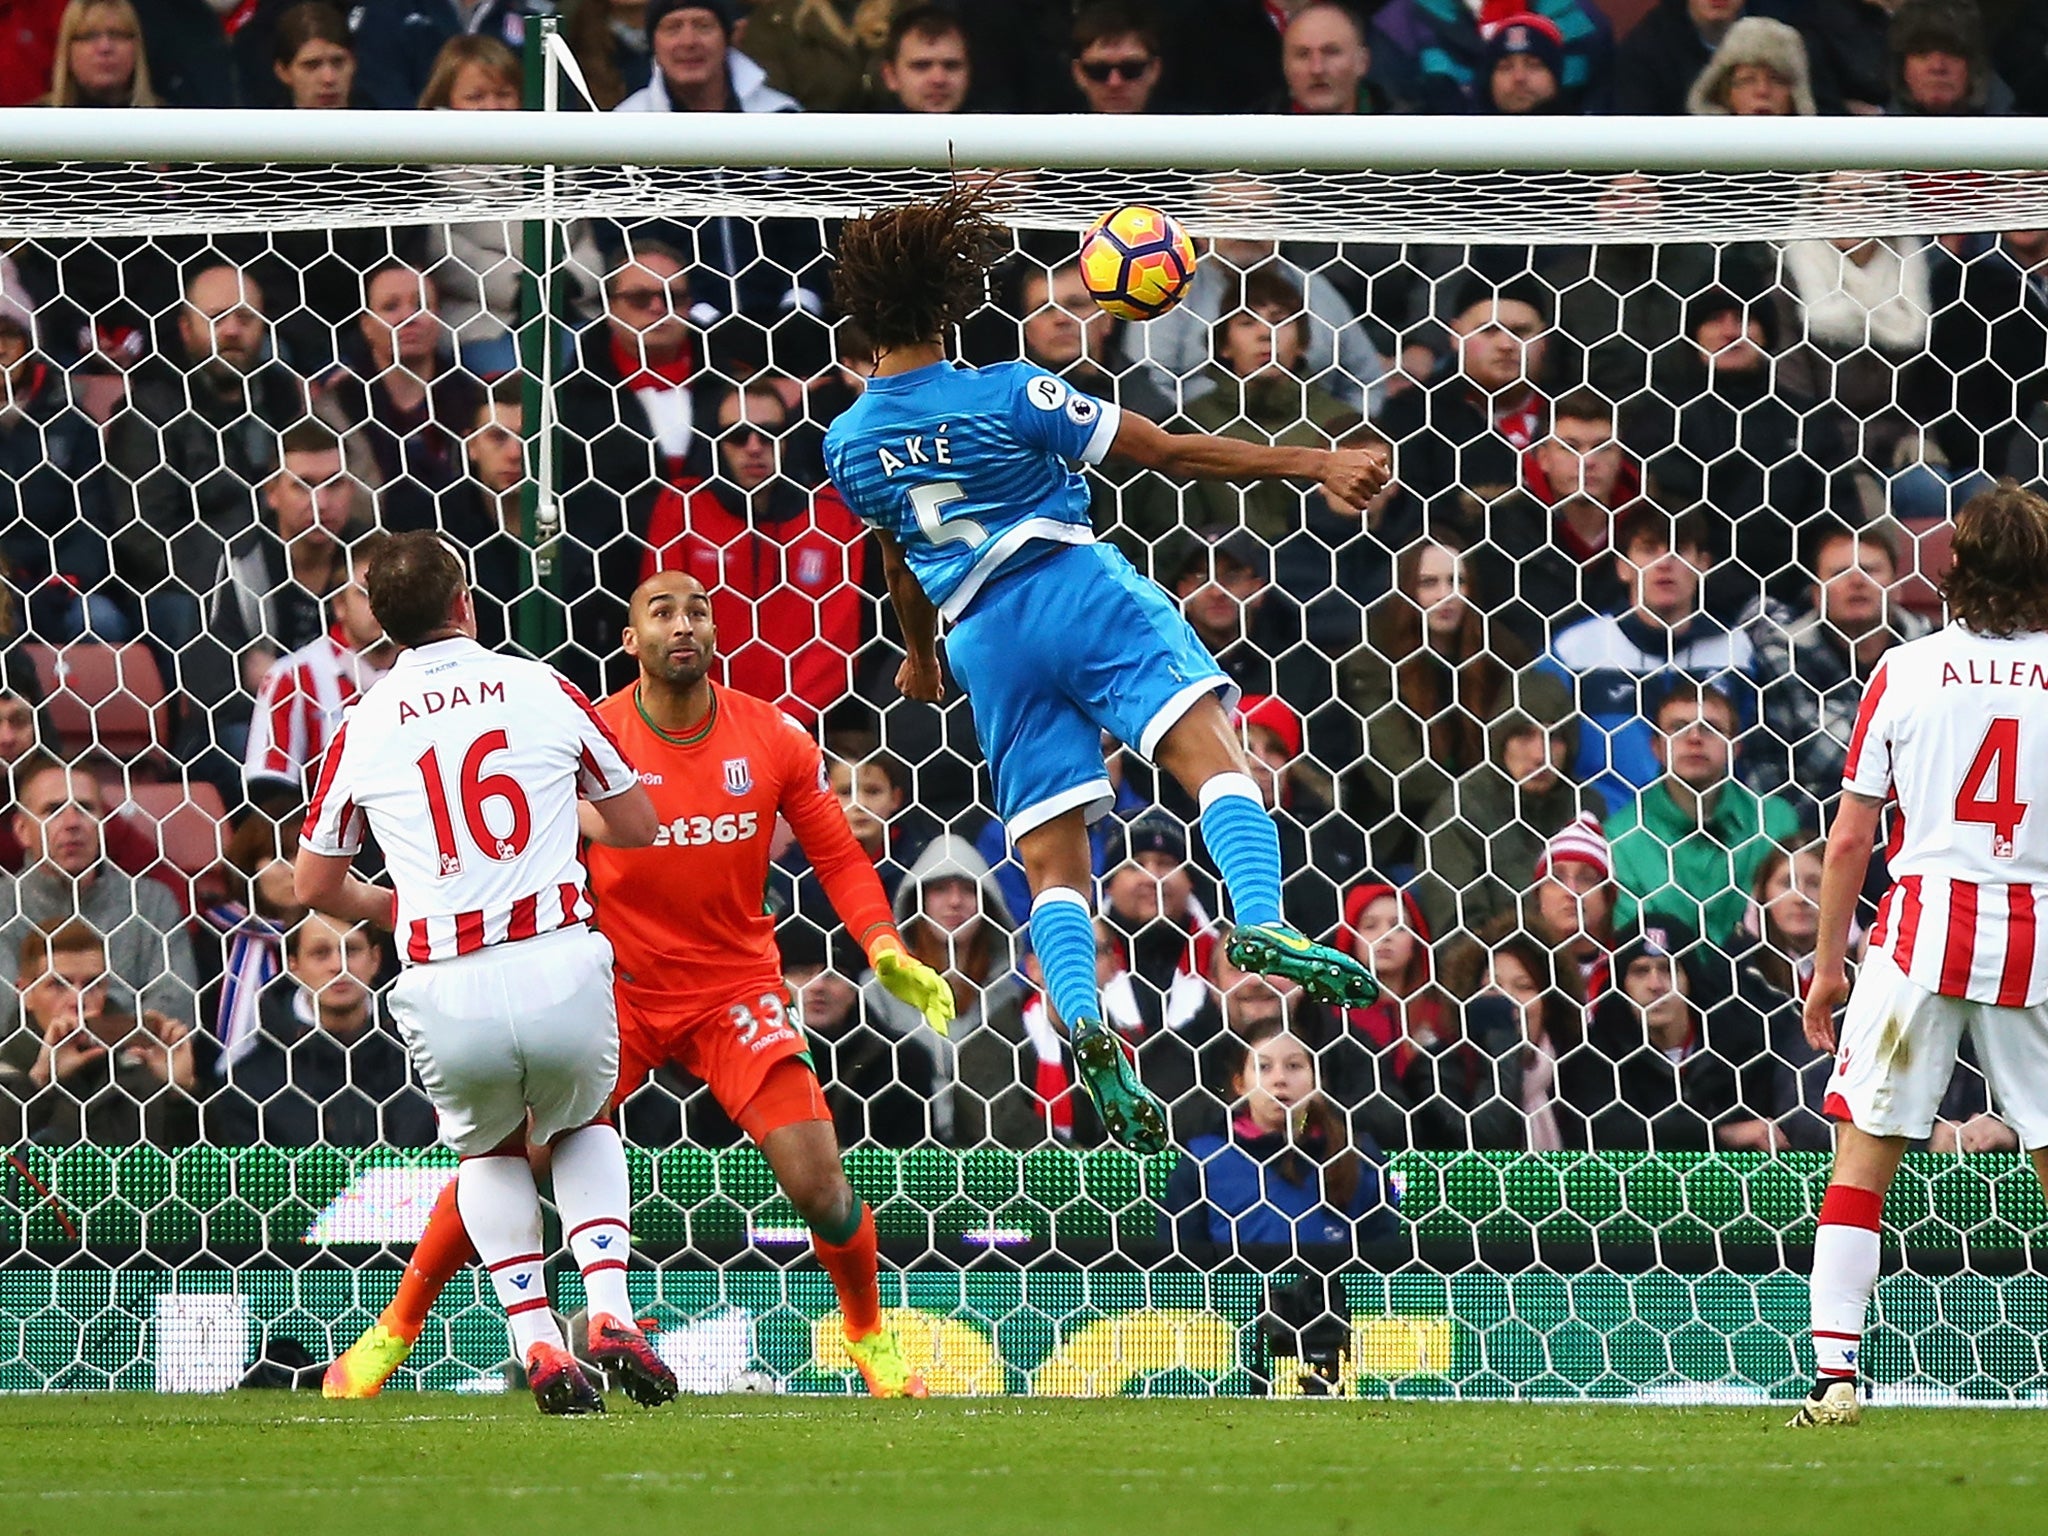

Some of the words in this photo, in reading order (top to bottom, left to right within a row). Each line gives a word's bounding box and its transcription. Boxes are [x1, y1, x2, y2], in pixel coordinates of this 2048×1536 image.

[1038, 379, 1057, 406] JD
[878, 422, 953, 477] AKÉ
[906, 481, 990, 549] 5
[399, 680, 505, 726] ADAM
[415, 728, 531, 877] 16
[1954, 717, 2030, 858] 4
[652, 811, 758, 847] et365
[729, 991, 783, 1046] 33
